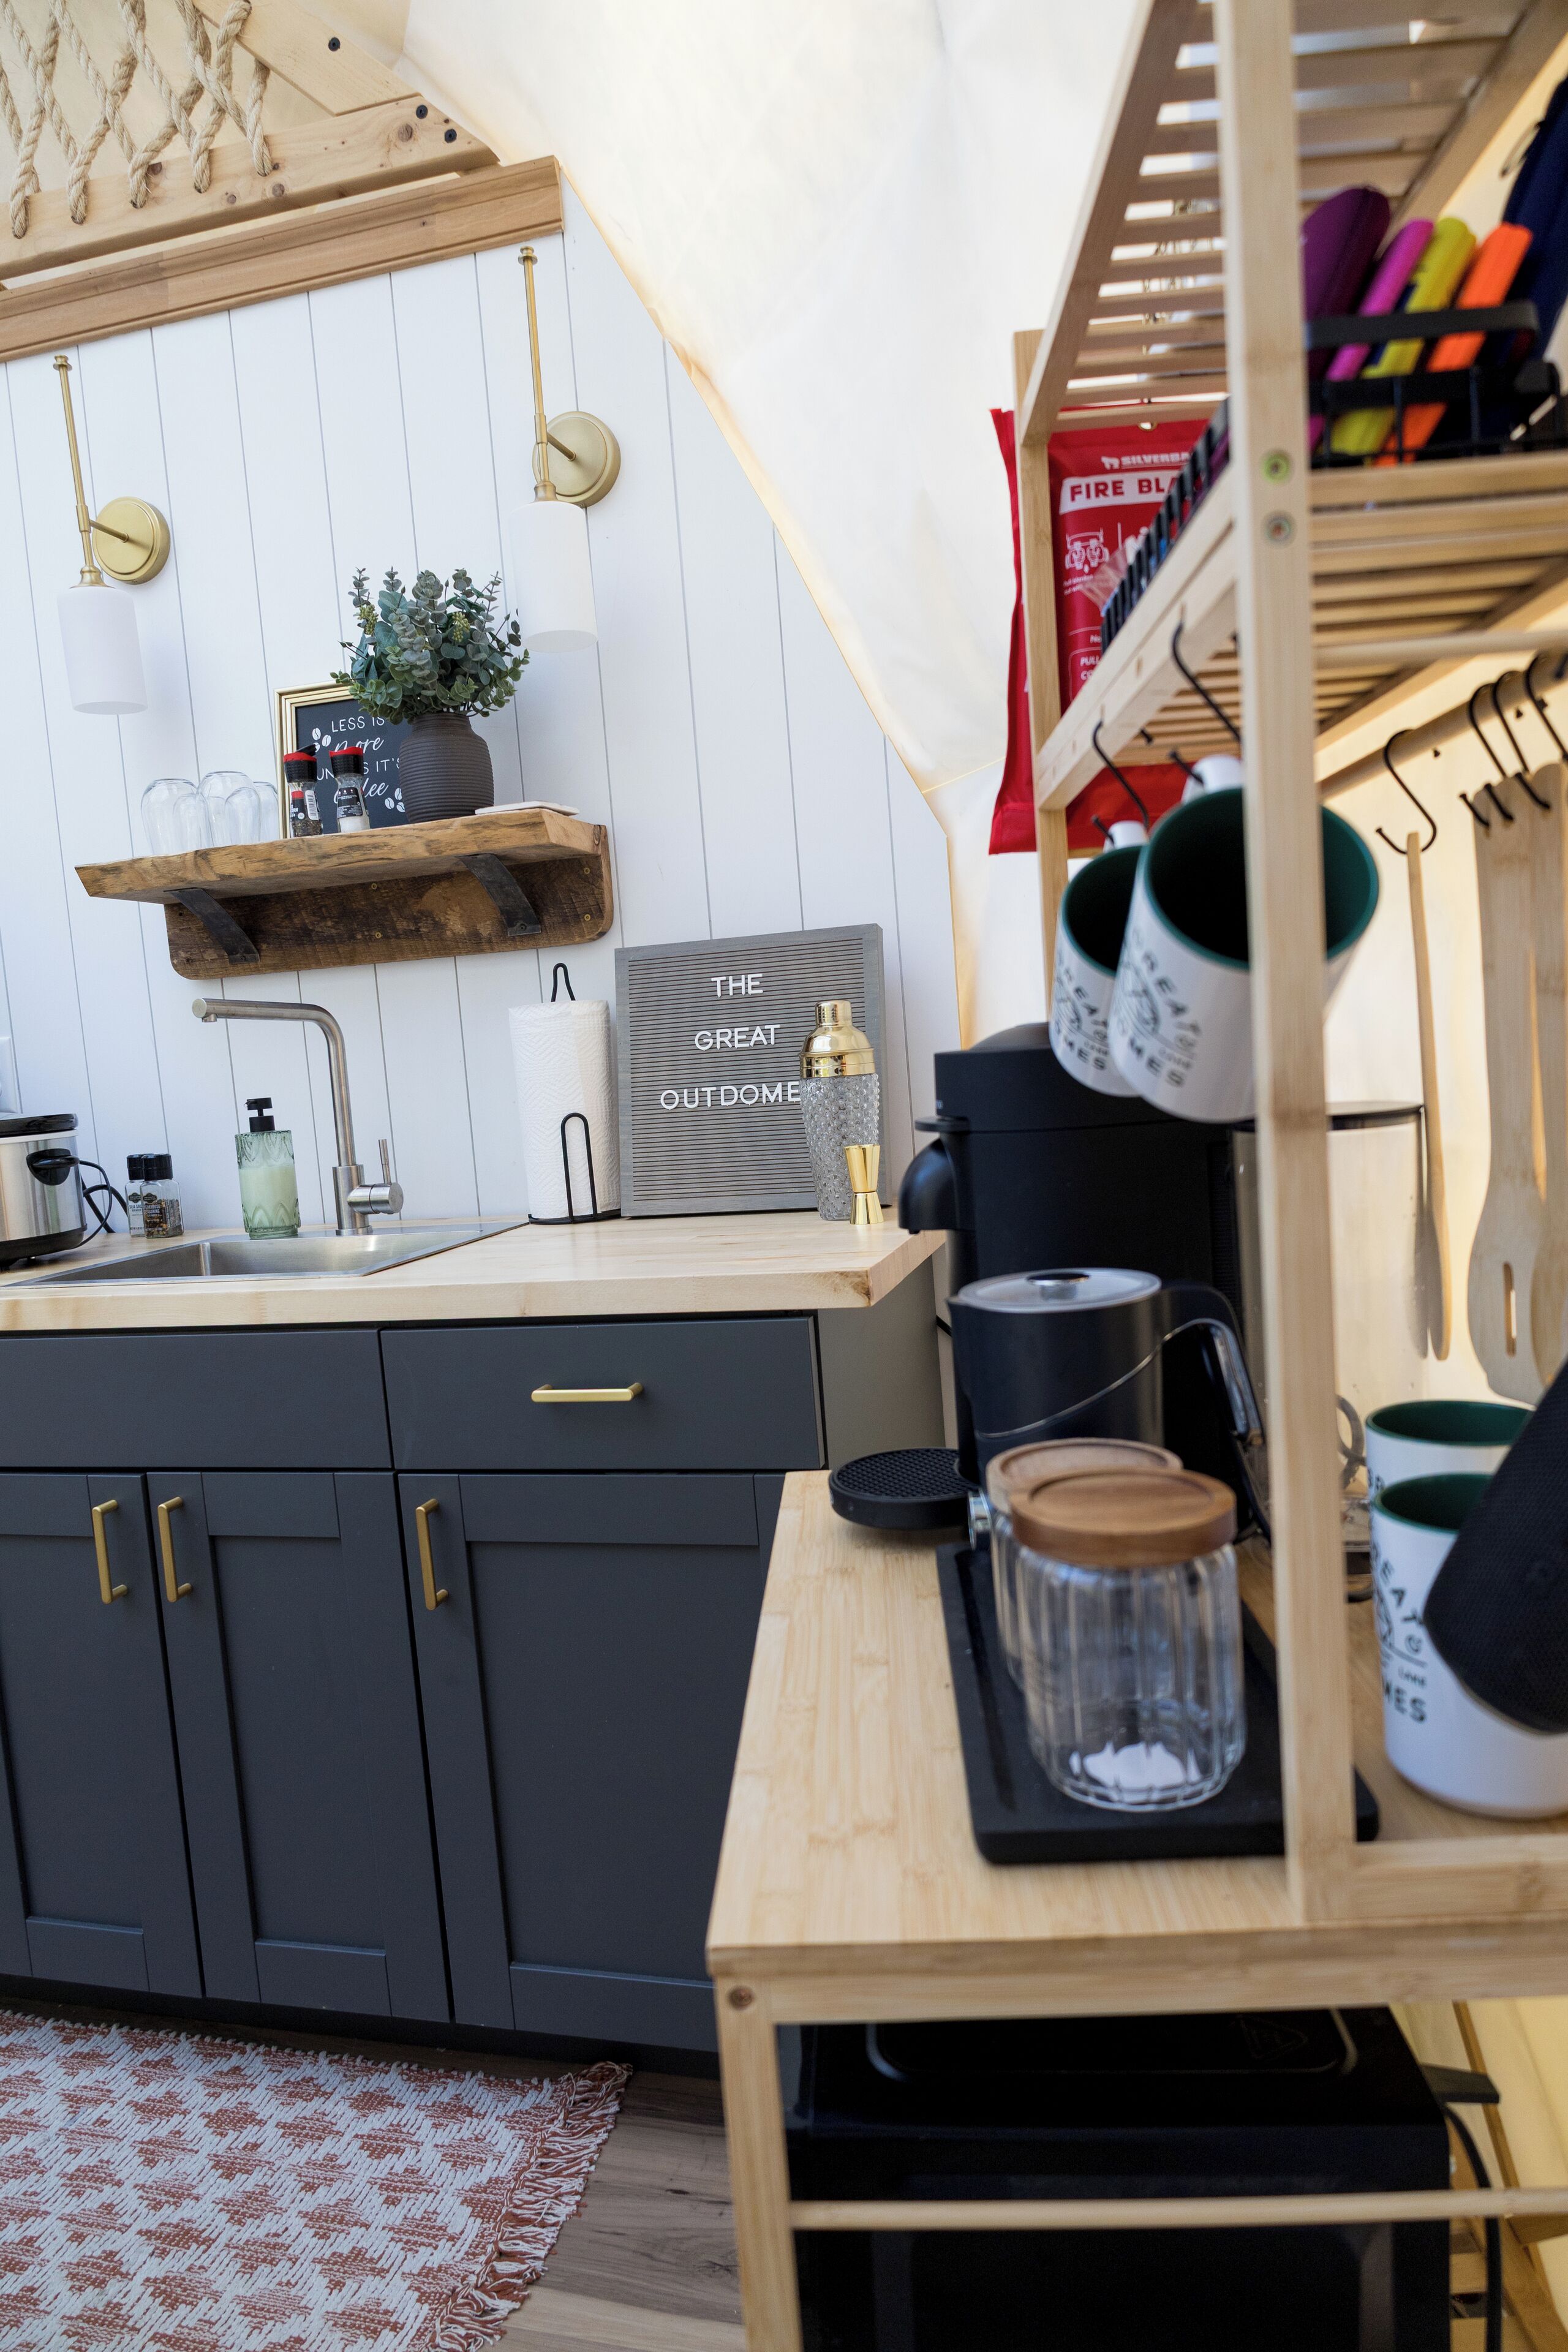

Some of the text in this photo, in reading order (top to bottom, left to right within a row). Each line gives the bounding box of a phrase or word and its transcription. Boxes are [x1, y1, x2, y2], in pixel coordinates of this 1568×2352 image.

[1070, 480, 1124, 502] FIRE
[331, 715, 365, 733] LESS
[711, 973, 764, 997] THE
[695, 1024, 781, 1051] GREAT
[660, 1081, 801, 1110] OUTDOME
